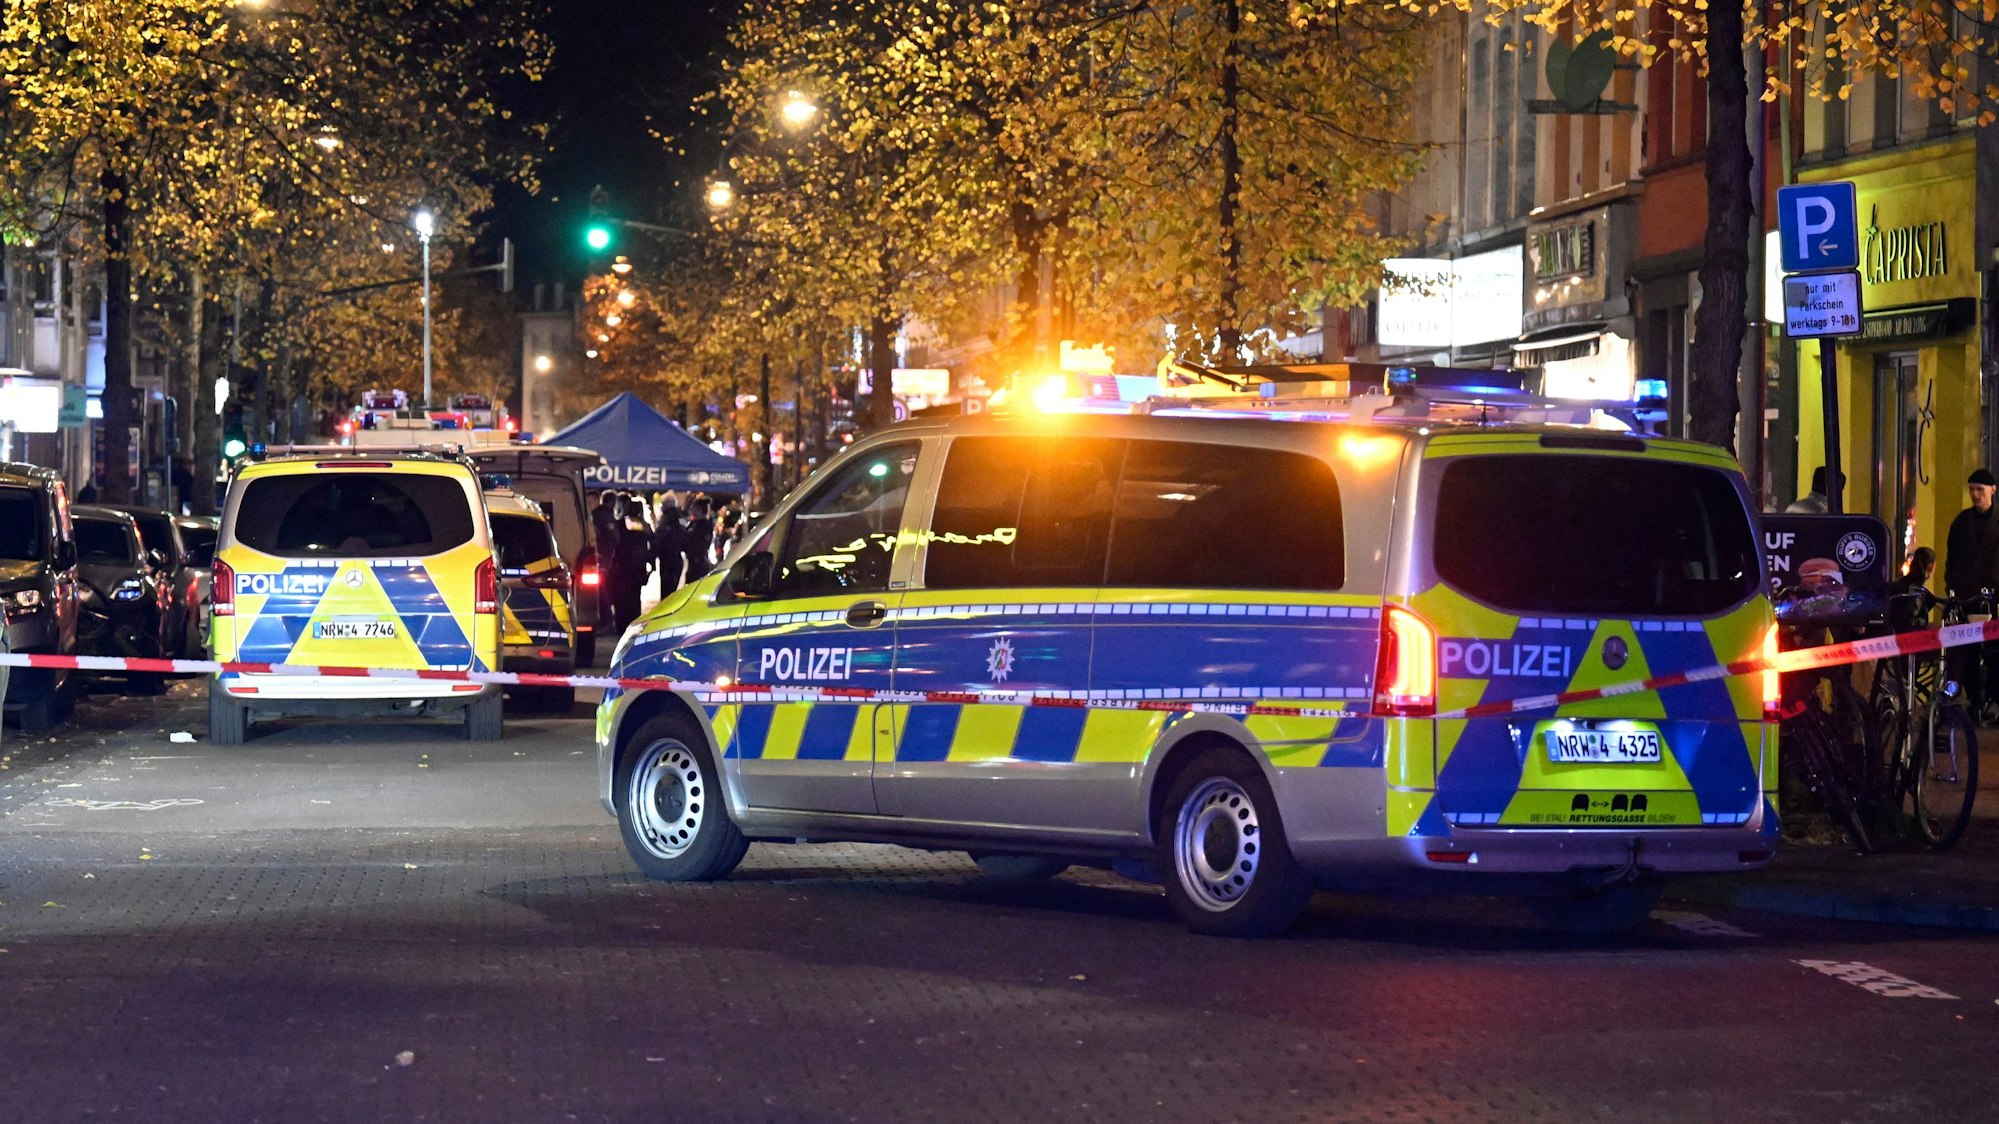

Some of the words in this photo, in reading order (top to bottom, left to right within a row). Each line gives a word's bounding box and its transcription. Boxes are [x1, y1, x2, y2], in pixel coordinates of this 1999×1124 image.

[1796, 196, 1836, 260] P
[1864, 221, 1946, 285] CAPRISTA
[1805, 284, 1819, 295] nur
[1822, 281, 1837, 293] mit
[1799, 298, 1844, 312] Parkschein
[1790, 316, 1828, 330] werktags
[583, 465, 667, 484] POLIZEI
[237, 574, 323, 594] POLIZEI
[321, 624, 344, 636] NRW
[351, 624, 358, 636] 4
[364, 624, 395, 636] 7746
[759, 646, 852, 681] POLIZEI
[1440, 641, 1572, 677] POLIZEI
[1557, 734, 1590, 757] NRW
[1600, 734, 1609, 757] 4
[1619, 734, 1658, 757] 4325
[1530, 813, 1543, 822] BEI
[1569, 813, 1646, 823] RETTUNGSGASSE
